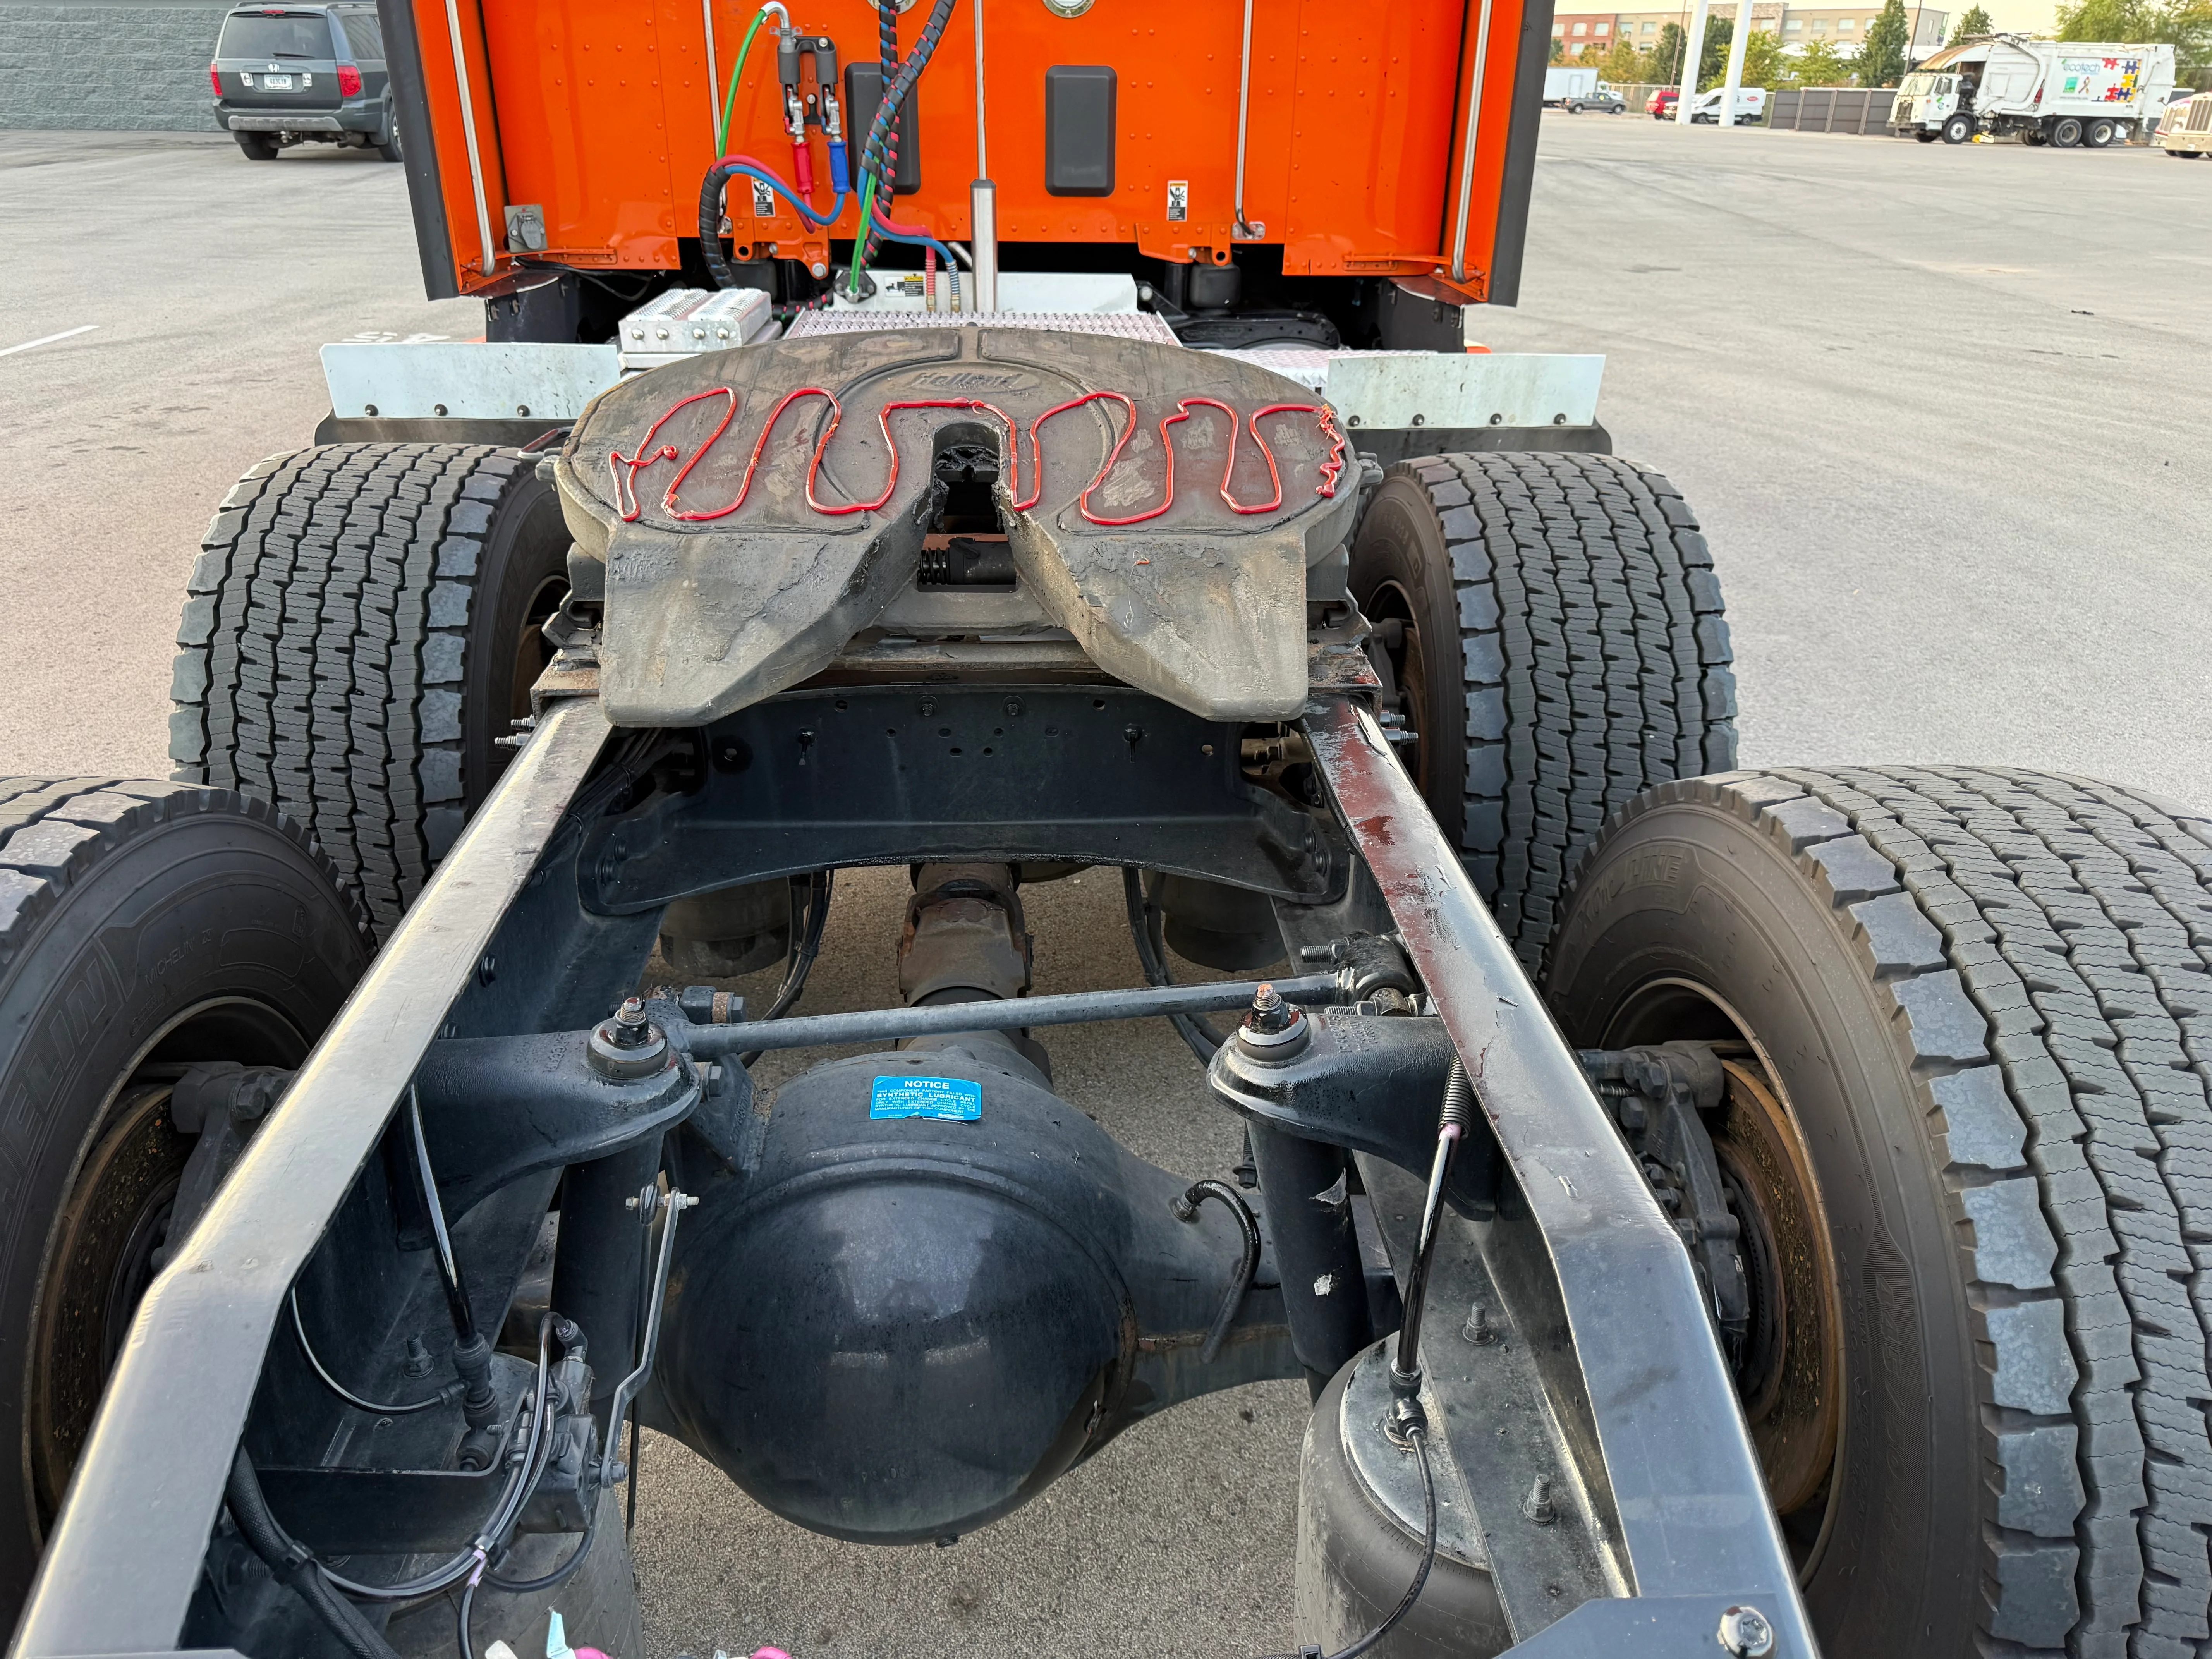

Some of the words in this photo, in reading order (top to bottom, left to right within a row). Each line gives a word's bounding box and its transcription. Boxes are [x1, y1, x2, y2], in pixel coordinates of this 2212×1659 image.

[2063, 62, 2100, 72] ecotech
[145, 937, 194, 988] MICHELIN
[904, 1080, 950, 1089] NOTICE
[929, 1093, 975, 1102] LUBRICANT
